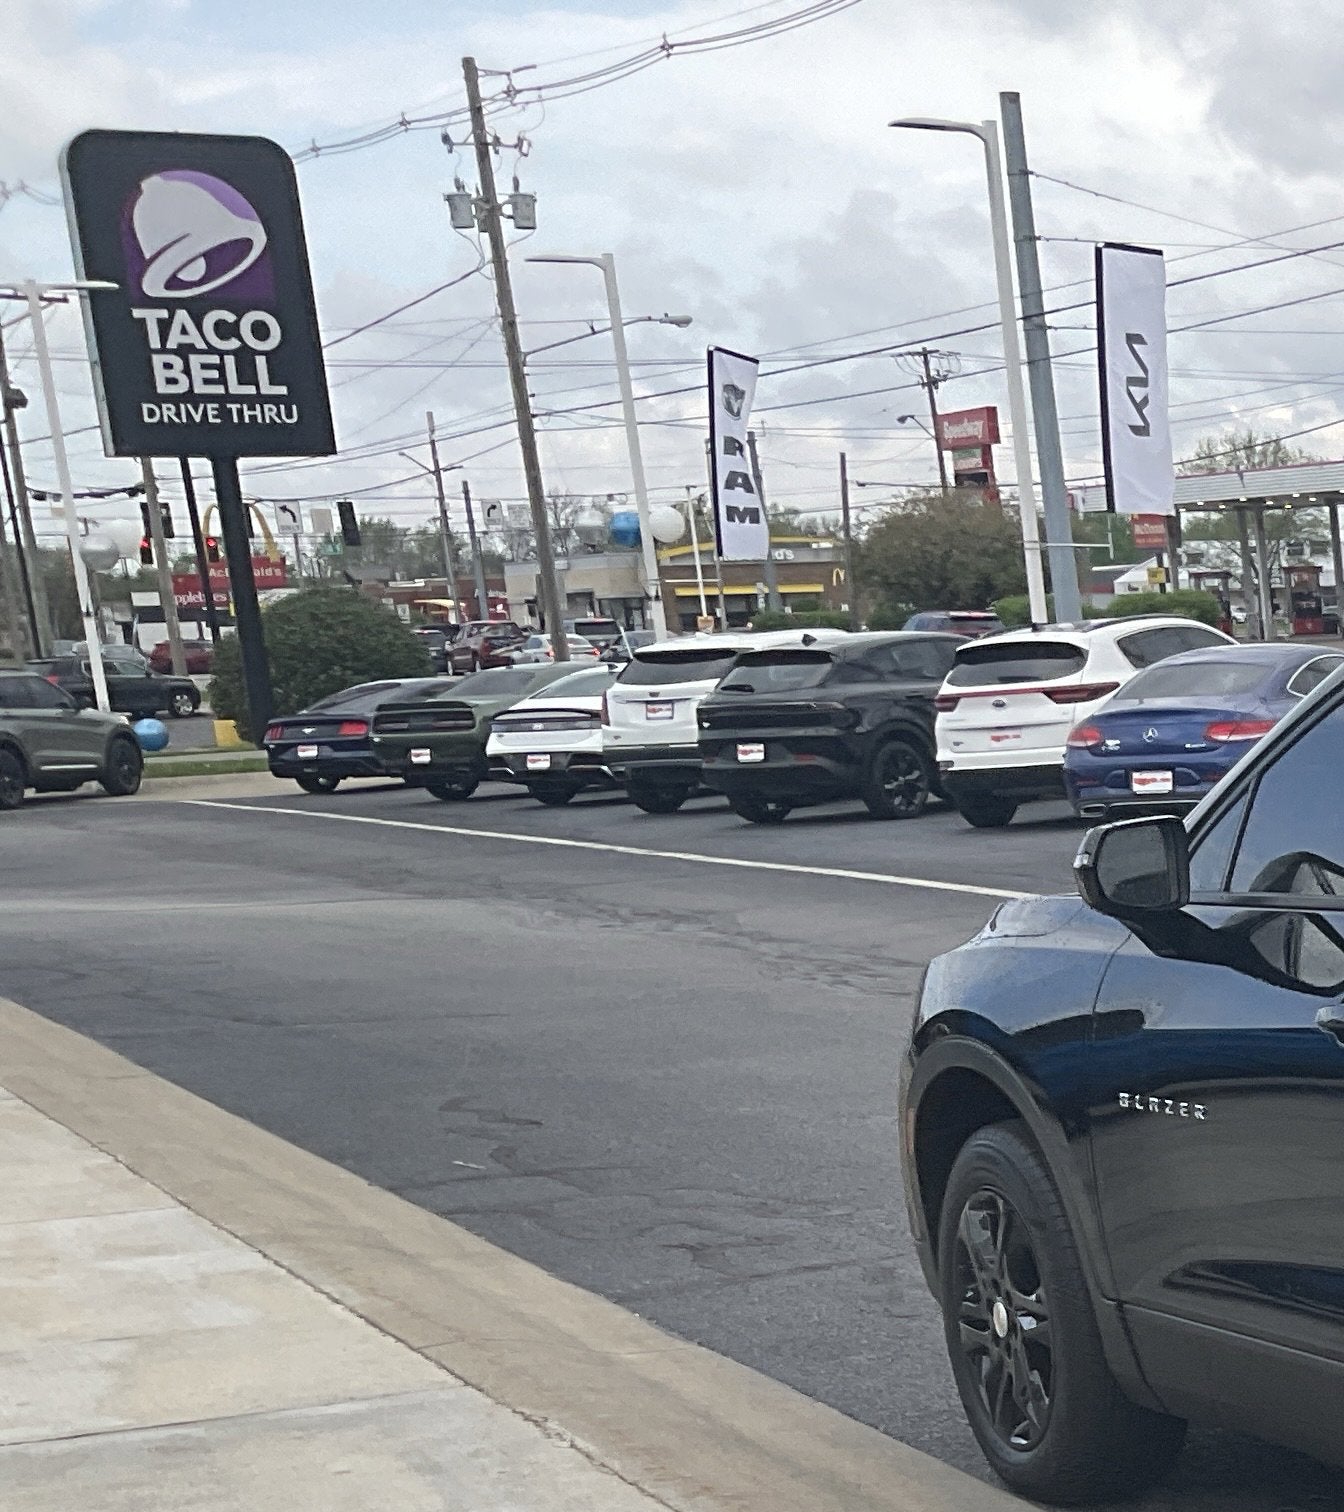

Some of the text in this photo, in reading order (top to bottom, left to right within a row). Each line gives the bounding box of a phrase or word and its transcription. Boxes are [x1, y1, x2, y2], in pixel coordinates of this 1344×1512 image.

[131, 308, 282, 351] TACO
[151, 353, 288, 395] BELL
[141, 402, 299, 424] DRIVE THRU
[723, 435, 760, 525] RAM
[1119, 1092, 1206, 1119] BLAZER
